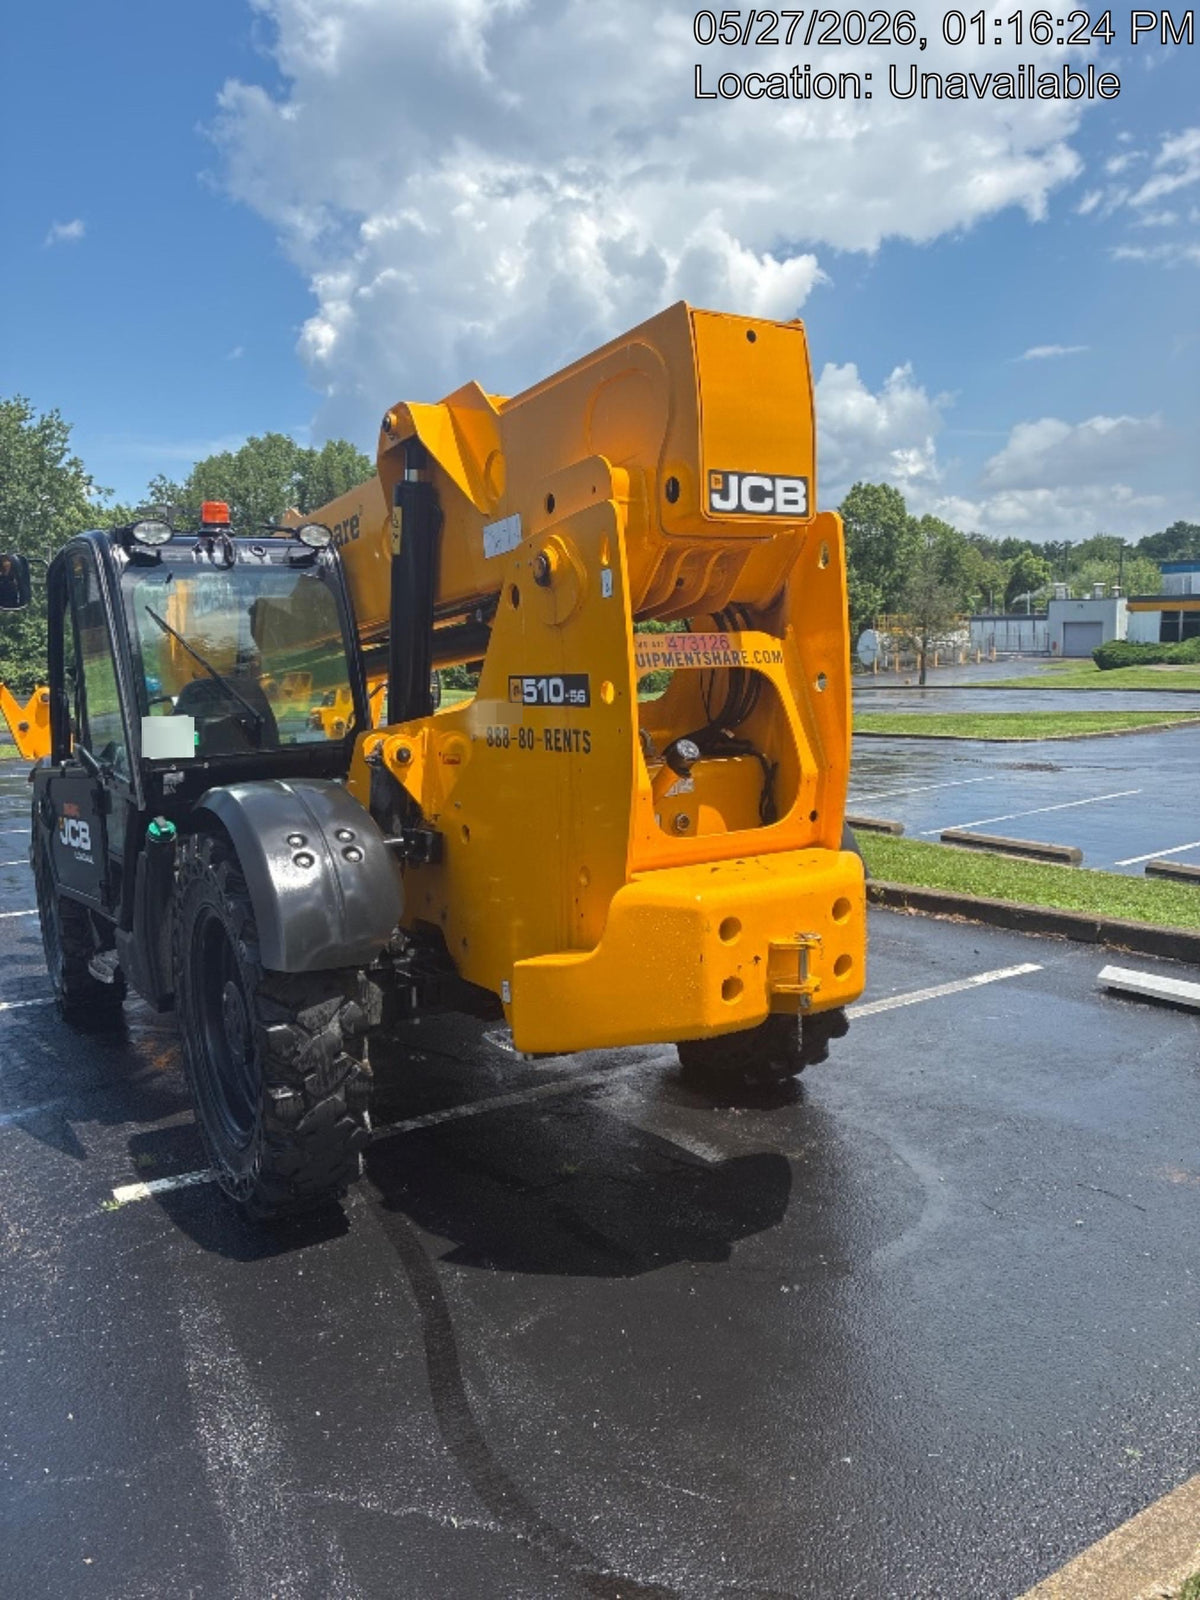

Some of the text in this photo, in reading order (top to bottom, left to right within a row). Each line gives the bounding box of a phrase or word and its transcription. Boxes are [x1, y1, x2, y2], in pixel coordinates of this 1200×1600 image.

[711, 474, 806, 513] JCB
[332, 512, 360, 547] are
[667, 634, 730, 651] 473126
[635, 650, 783, 668] UIPMENTSHARE.COM
[522, 677, 586, 703] 510-56
[60, 817, 91, 850] JCB
